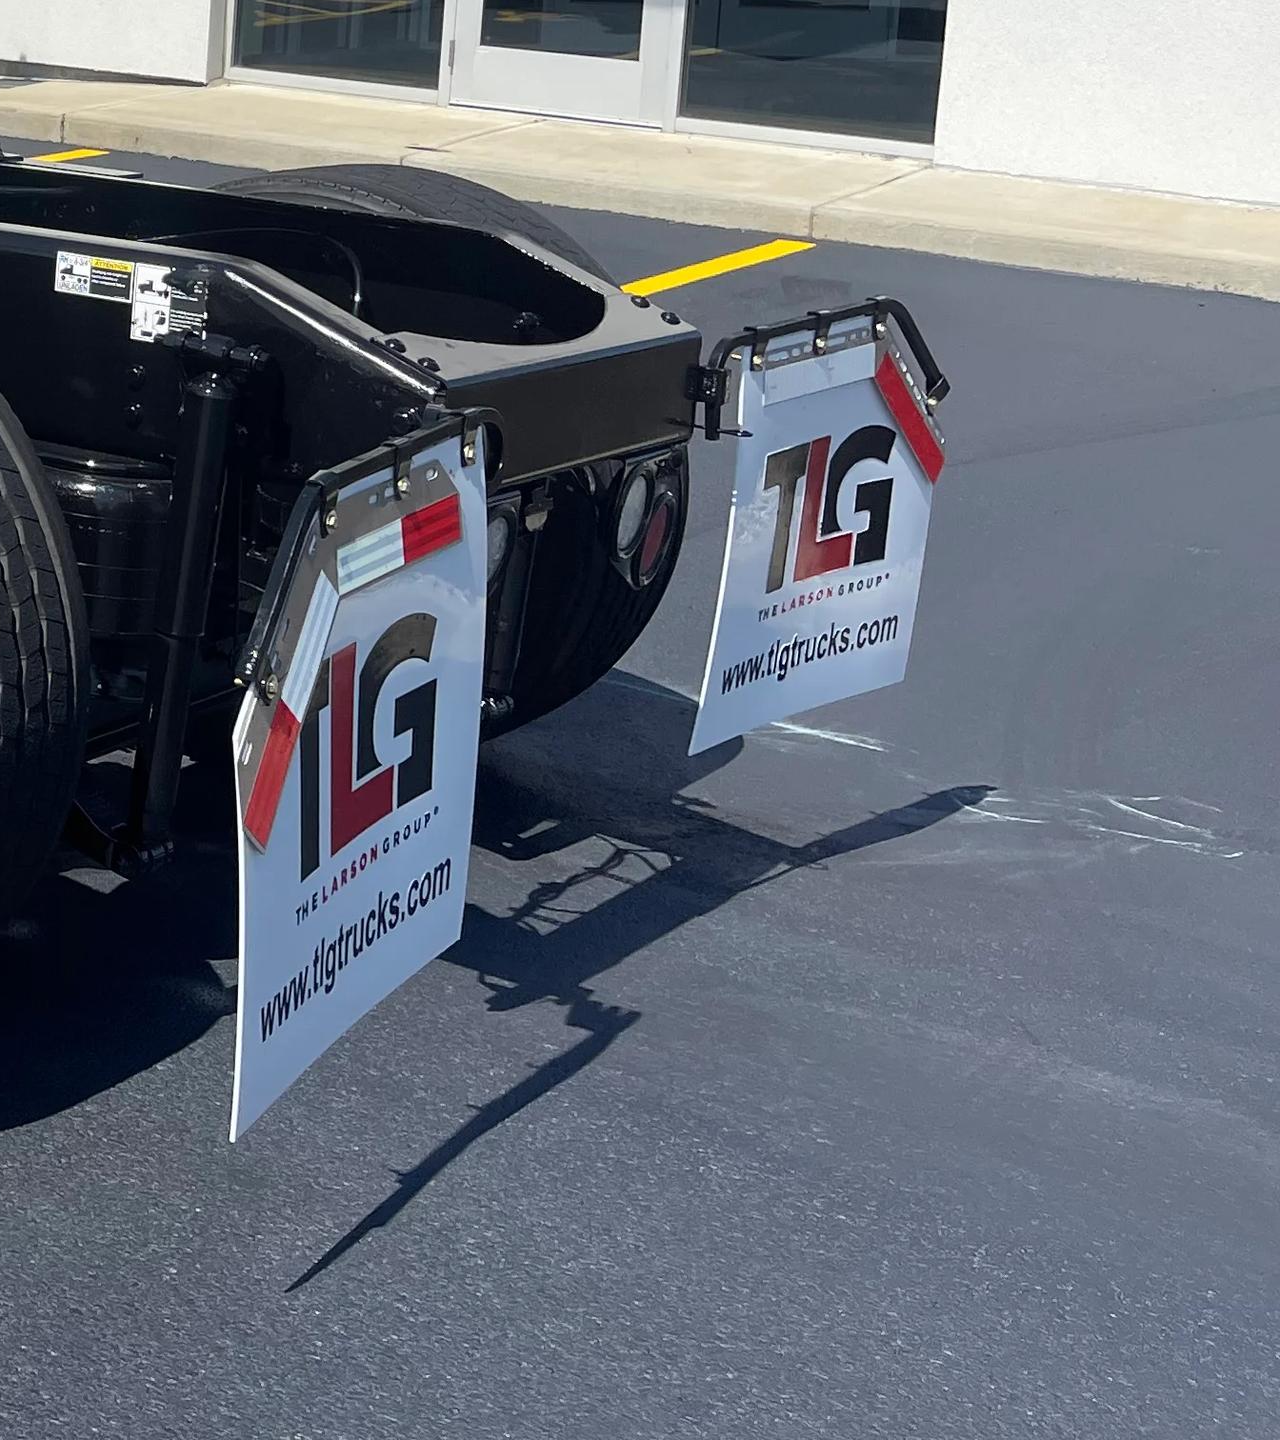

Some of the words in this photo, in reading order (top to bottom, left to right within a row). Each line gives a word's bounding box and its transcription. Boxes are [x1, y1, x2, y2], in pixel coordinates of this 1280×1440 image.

[94, 260, 129, 270] ATTENTION
[762, 425, 897, 594] TLG
[757, 604, 779, 622] THE
[780, 587, 833, 613] LARSON
[721, 614, 899, 695] www.tlgtrucks.com
[299, 612, 438, 884] TLG
[295, 895, 319, 927] THE
[321, 843, 378, 904] LARSON
[260, 856, 453, 1043] www.tlgtrucks.com
